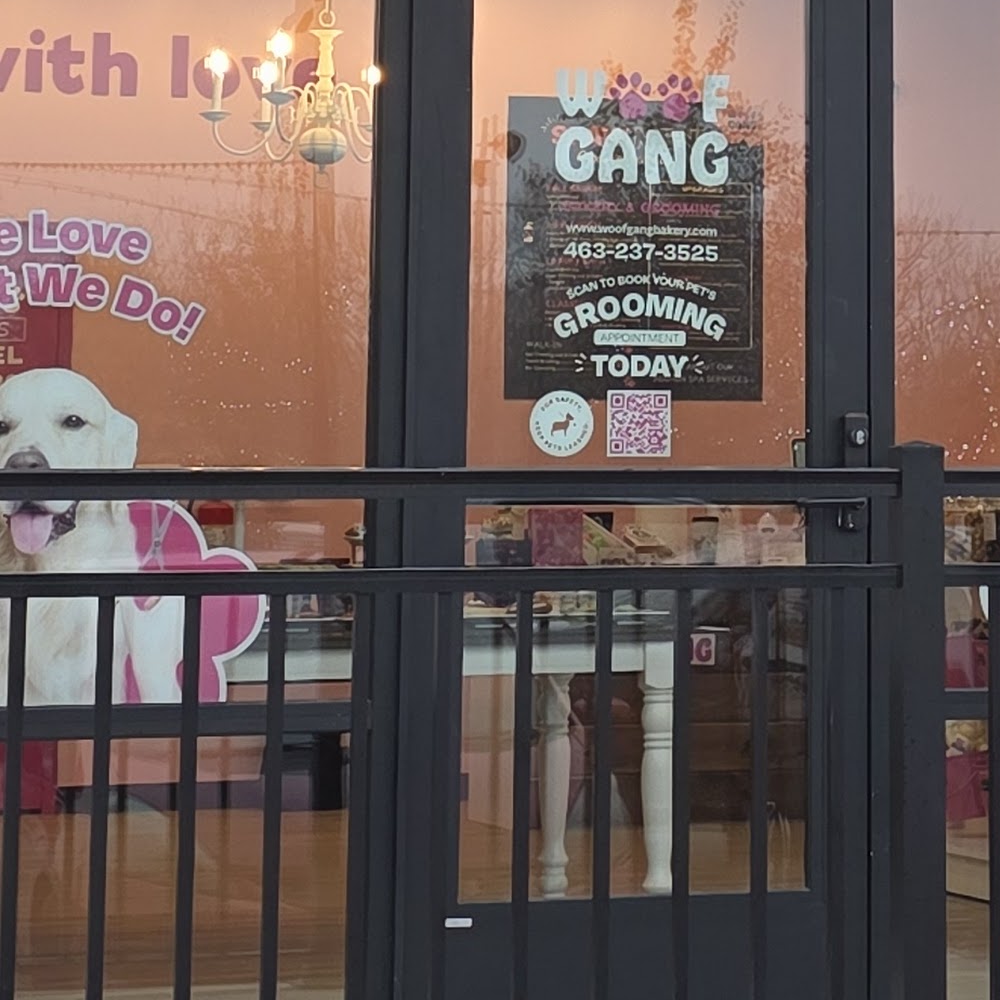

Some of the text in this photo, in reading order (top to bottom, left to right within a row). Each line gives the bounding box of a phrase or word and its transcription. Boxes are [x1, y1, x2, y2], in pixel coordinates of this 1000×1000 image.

[554, 126, 731, 187] GANG
[30, 212, 150, 263] Love
[565, 222, 718, 238] www.woofgangbakery.com
[563, 242, 719, 262] 463-237-3525
[566, 273, 717, 301] SCAN TO BOOK YOUR PET'S
[24, 265, 108, 309] We
[112, 276, 204, 343] Do!
[554, 293, 728, 342] GROOMING
[600, 332, 680, 344] APPOINTMENT
[591, 354, 689, 378] TODAY
